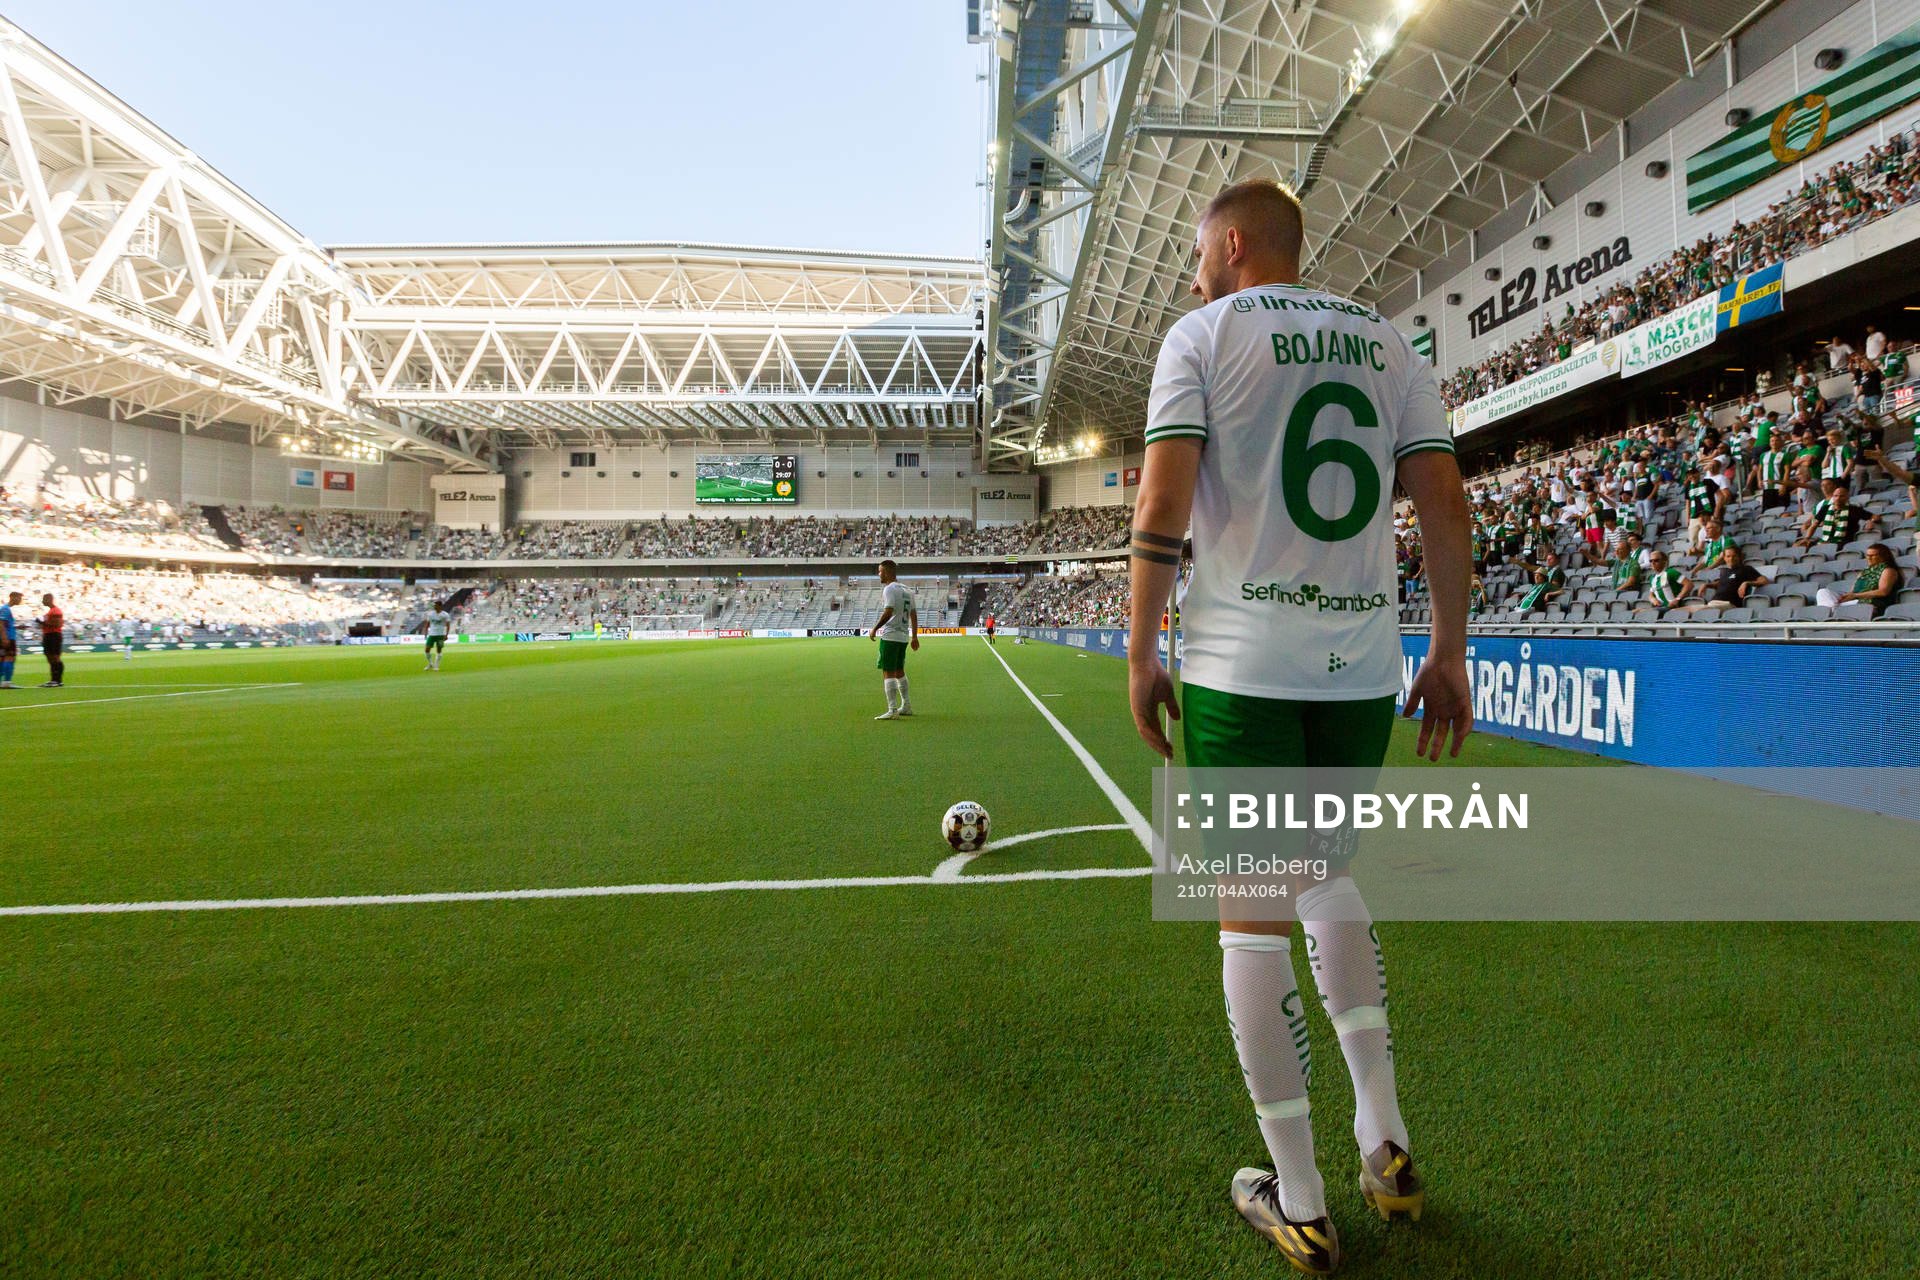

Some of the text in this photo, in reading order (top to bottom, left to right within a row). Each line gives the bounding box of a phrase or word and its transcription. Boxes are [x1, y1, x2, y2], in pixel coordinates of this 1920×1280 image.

[1468, 236, 1632, 339] TELE2 Arena
[1647, 326, 1714, 364] PROGRAM
[1648, 303, 1714, 350] MATCH
[1271, 329, 1386, 372] BOJANIC
[1490, 386, 1517, 406] POSITIV
[1518, 351, 1598, 393] SUPPORTERKULTUR
[1488, 380, 1568, 419] Hammarbyklanen
[774, 461, 780, 469] 0
[786, 461, 793, 469] 0
[1282, 381, 1381, 542] 6
[440, 491, 467, 501] TELE2
[980, 490, 1031, 500] TELE2 Arena
[1241, 582, 1306, 607] Sefina
